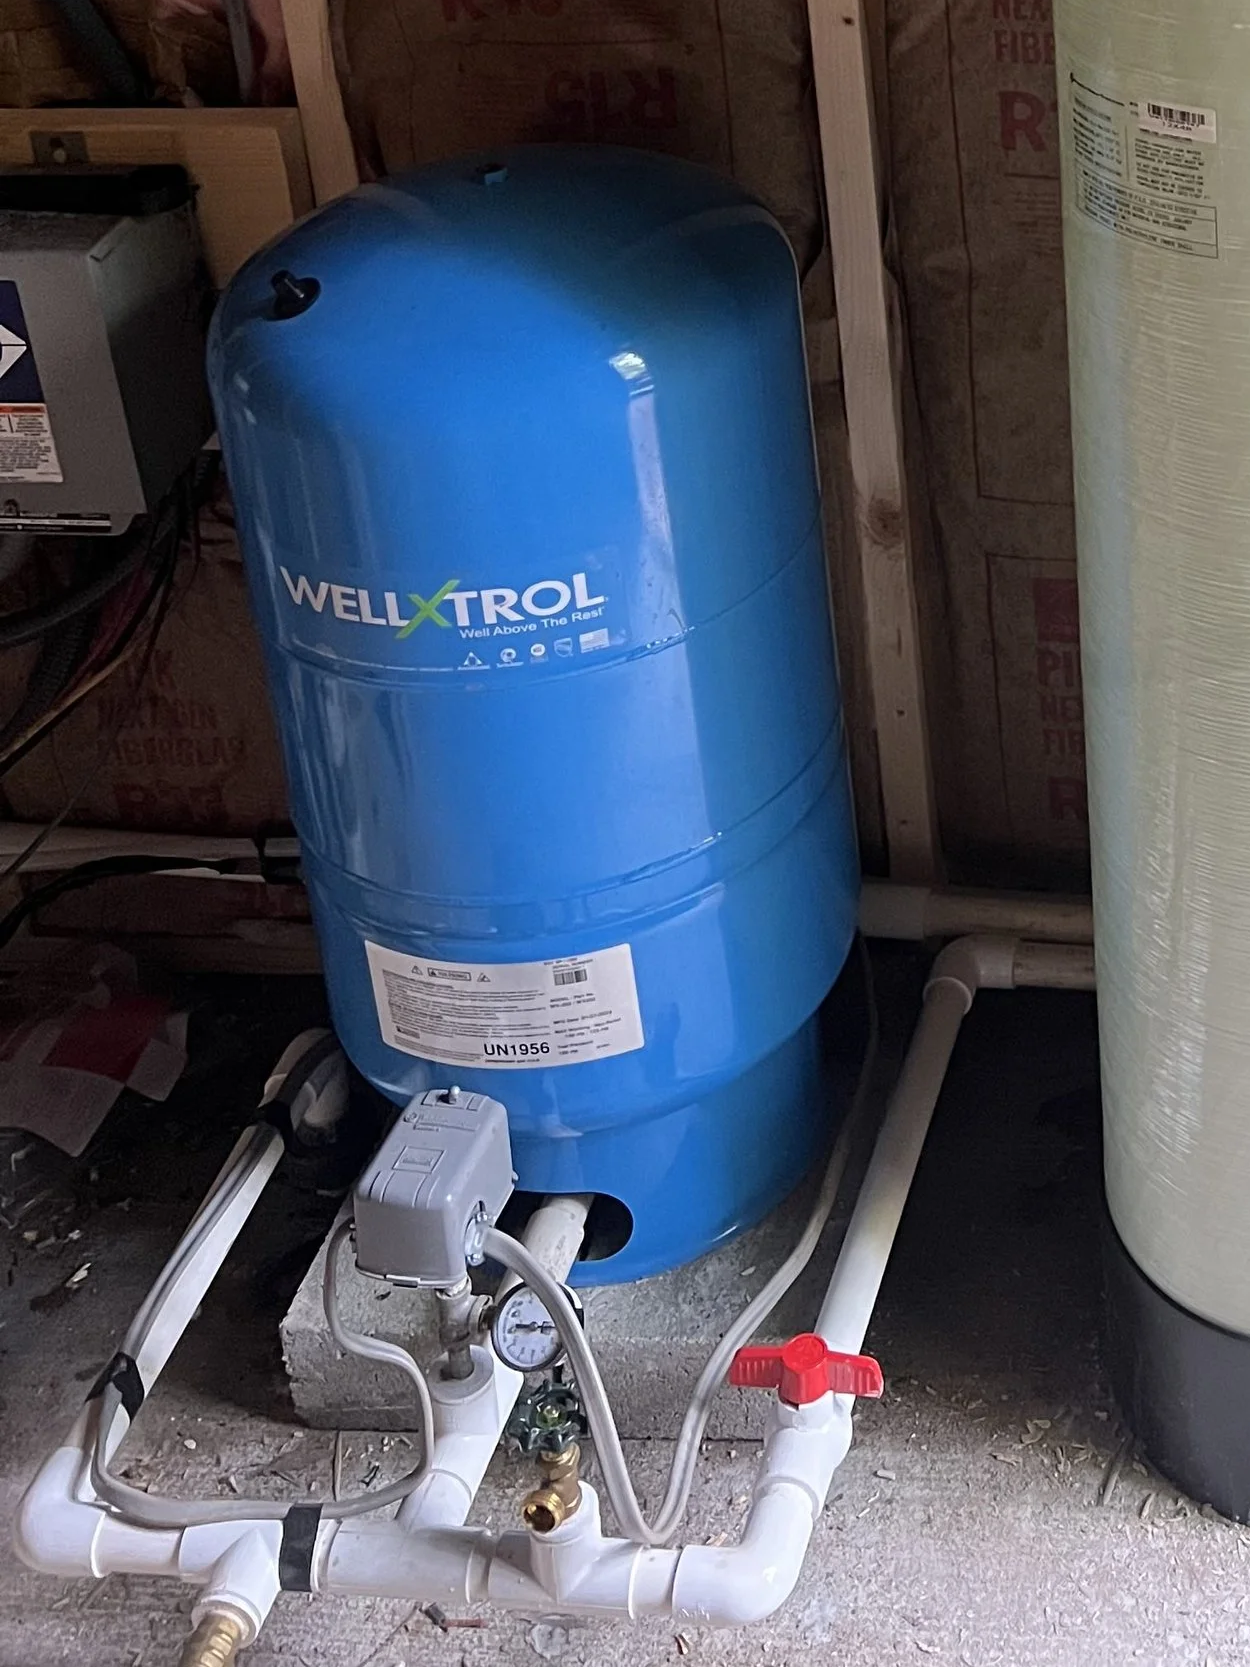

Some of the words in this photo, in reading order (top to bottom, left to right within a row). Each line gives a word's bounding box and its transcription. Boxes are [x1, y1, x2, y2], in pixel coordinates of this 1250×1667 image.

[459, 627, 490, 639] Well
[493, 623, 537, 637] Above
[541, 617, 568, 629] The
[483, 1042, 551, 1058] UN1956
